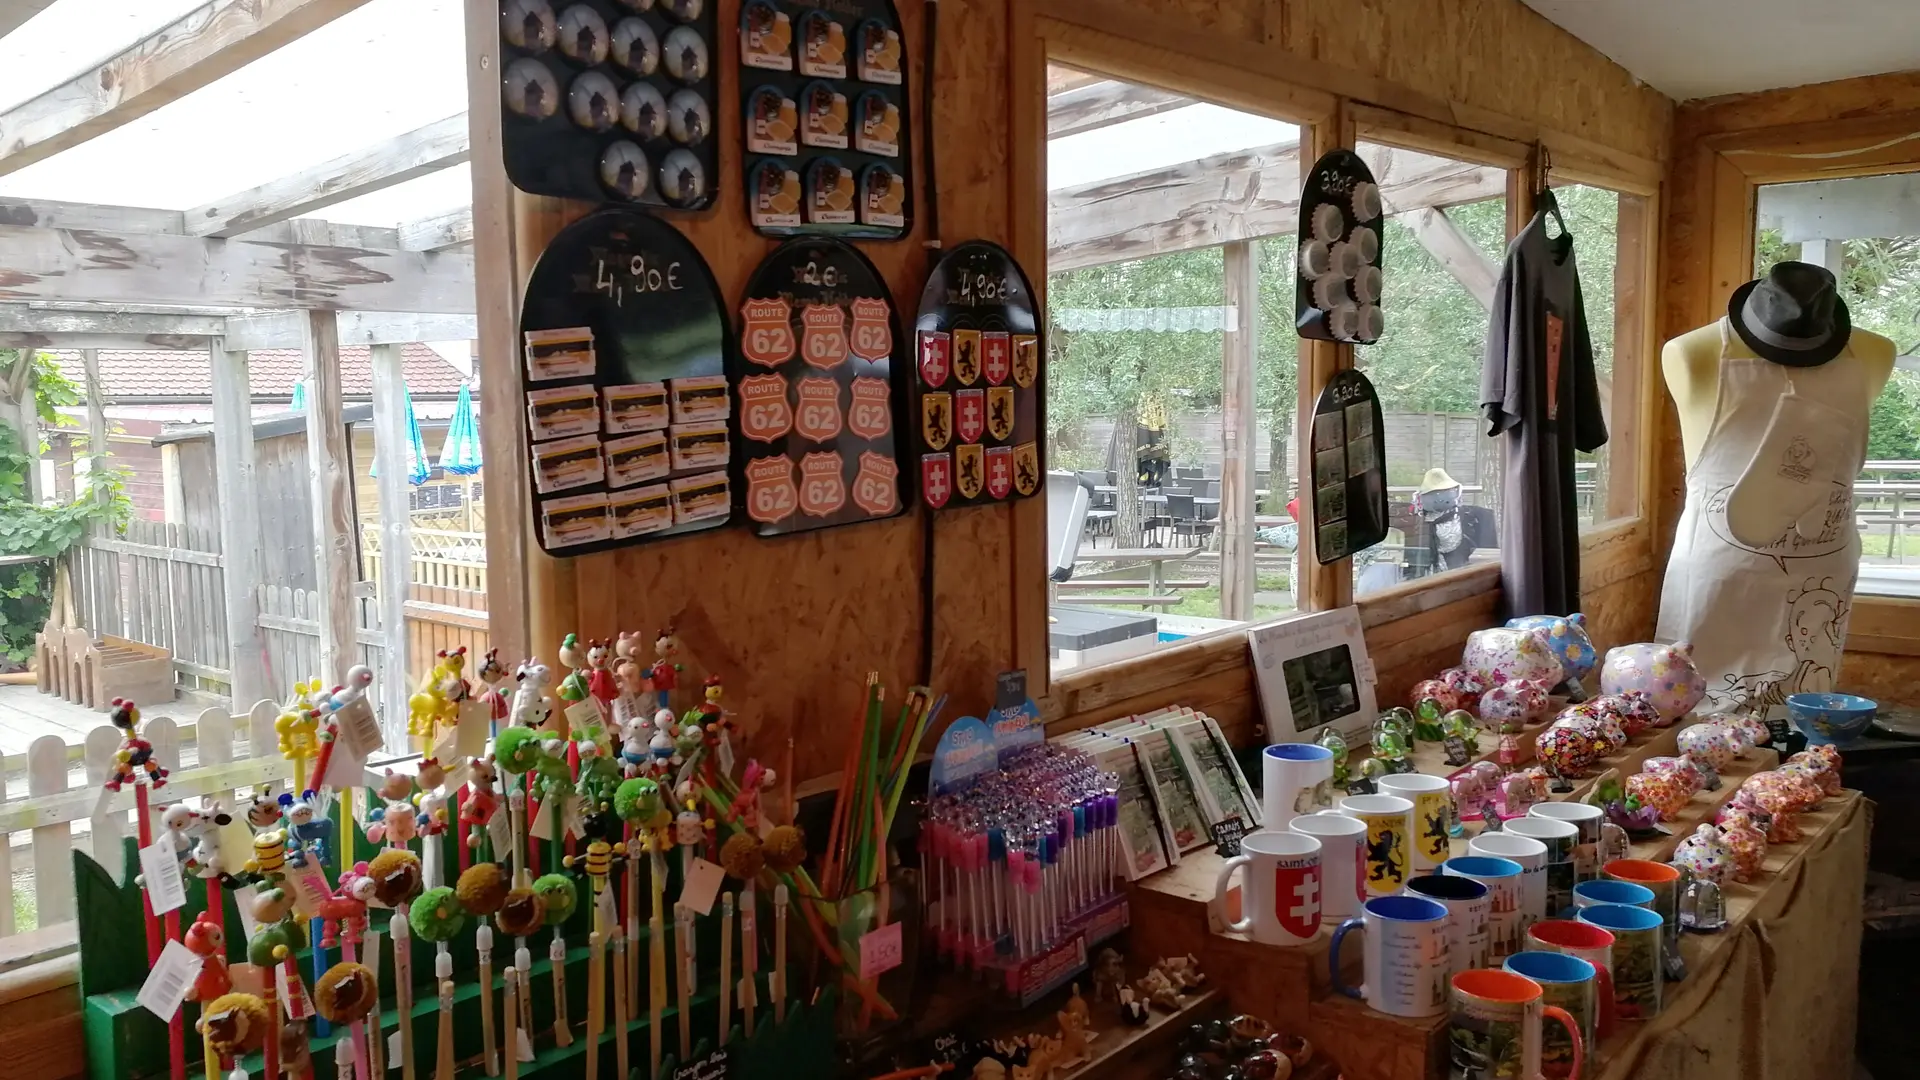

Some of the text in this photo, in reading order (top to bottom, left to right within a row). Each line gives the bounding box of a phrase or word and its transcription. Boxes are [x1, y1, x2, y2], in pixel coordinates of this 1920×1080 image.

[596, 255, 683, 307] 4,90€
[961, 272, 1009, 307] 4,90€
[751, 308, 783, 317] ROUTE
[809, 314, 838, 323] ROUTE
[858, 307, 884, 316] ROUTE
[752, 328, 788, 354] 62
[810, 333, 842, 358] 62
[858, 325, 886, 349] 62
[747, 383, 780, 394] ROUTE
[804, 386, 833, 395] ROUTE
[857, 386, 885, 395] ROUTE
[750, 402, 785, 430] 62
[804, 405, 835, 429] 62
[856, 404, 884, 429] 62
[754, 465, 787, 477] ROUTE
[808, 461, 836, 470] ROUTE
[865, 460, 893, 474] ROUTE
[755, 484, 790, 512] 62
[808, 479, 840, 504] 62
[860, 478, 890, 506] 62
